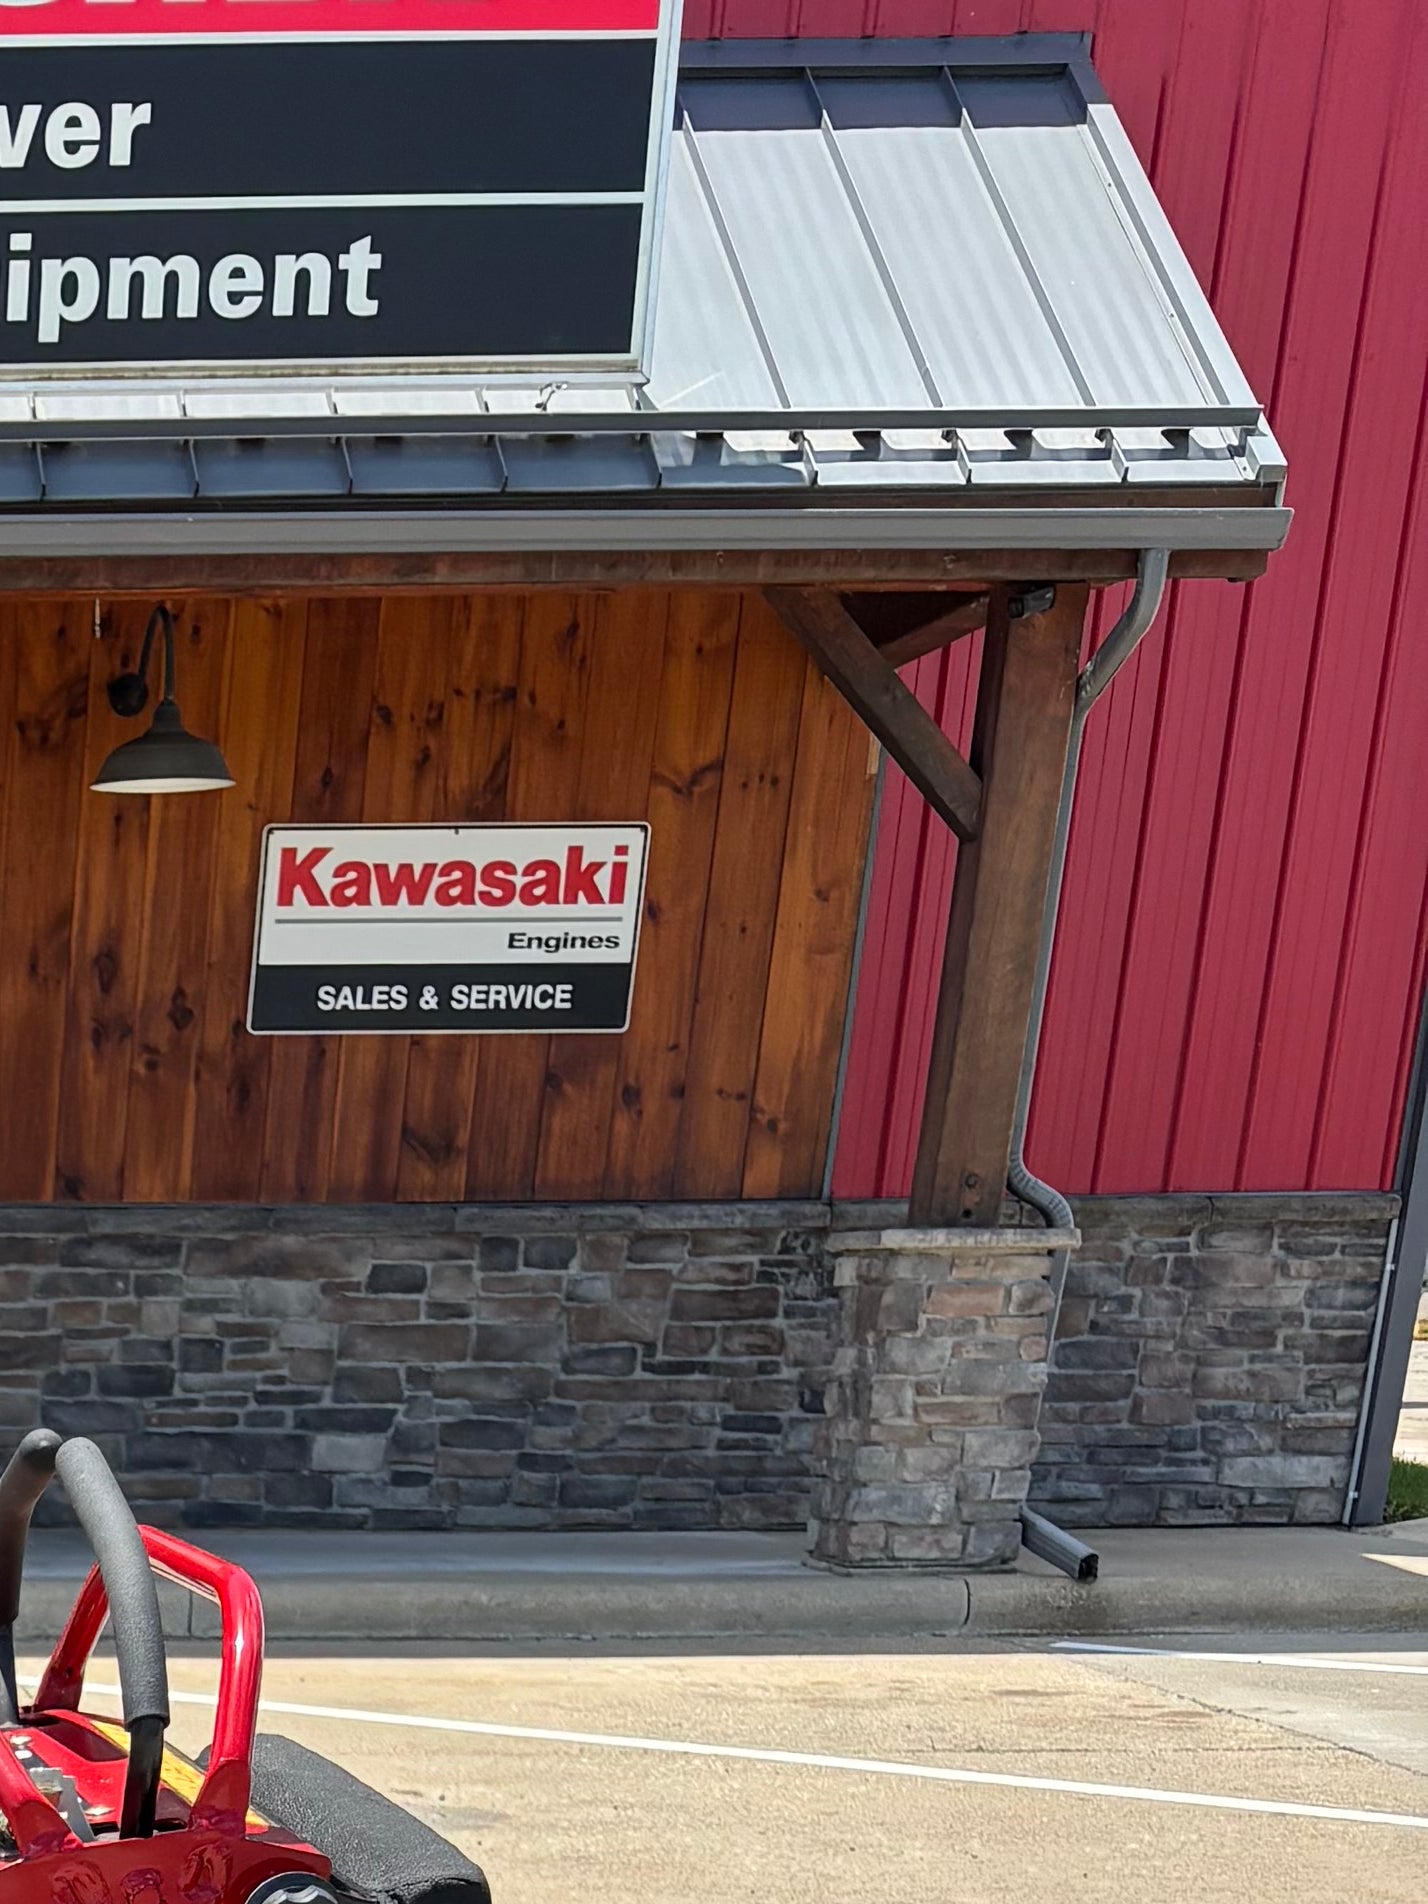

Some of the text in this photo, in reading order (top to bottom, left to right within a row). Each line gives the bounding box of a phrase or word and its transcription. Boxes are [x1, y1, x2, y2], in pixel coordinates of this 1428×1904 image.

[276, 845, 629, 907] Kawasaki
[508, 932, 620, 953] Engines
[317, 984, 573, 1011] SALES & SERVICE
